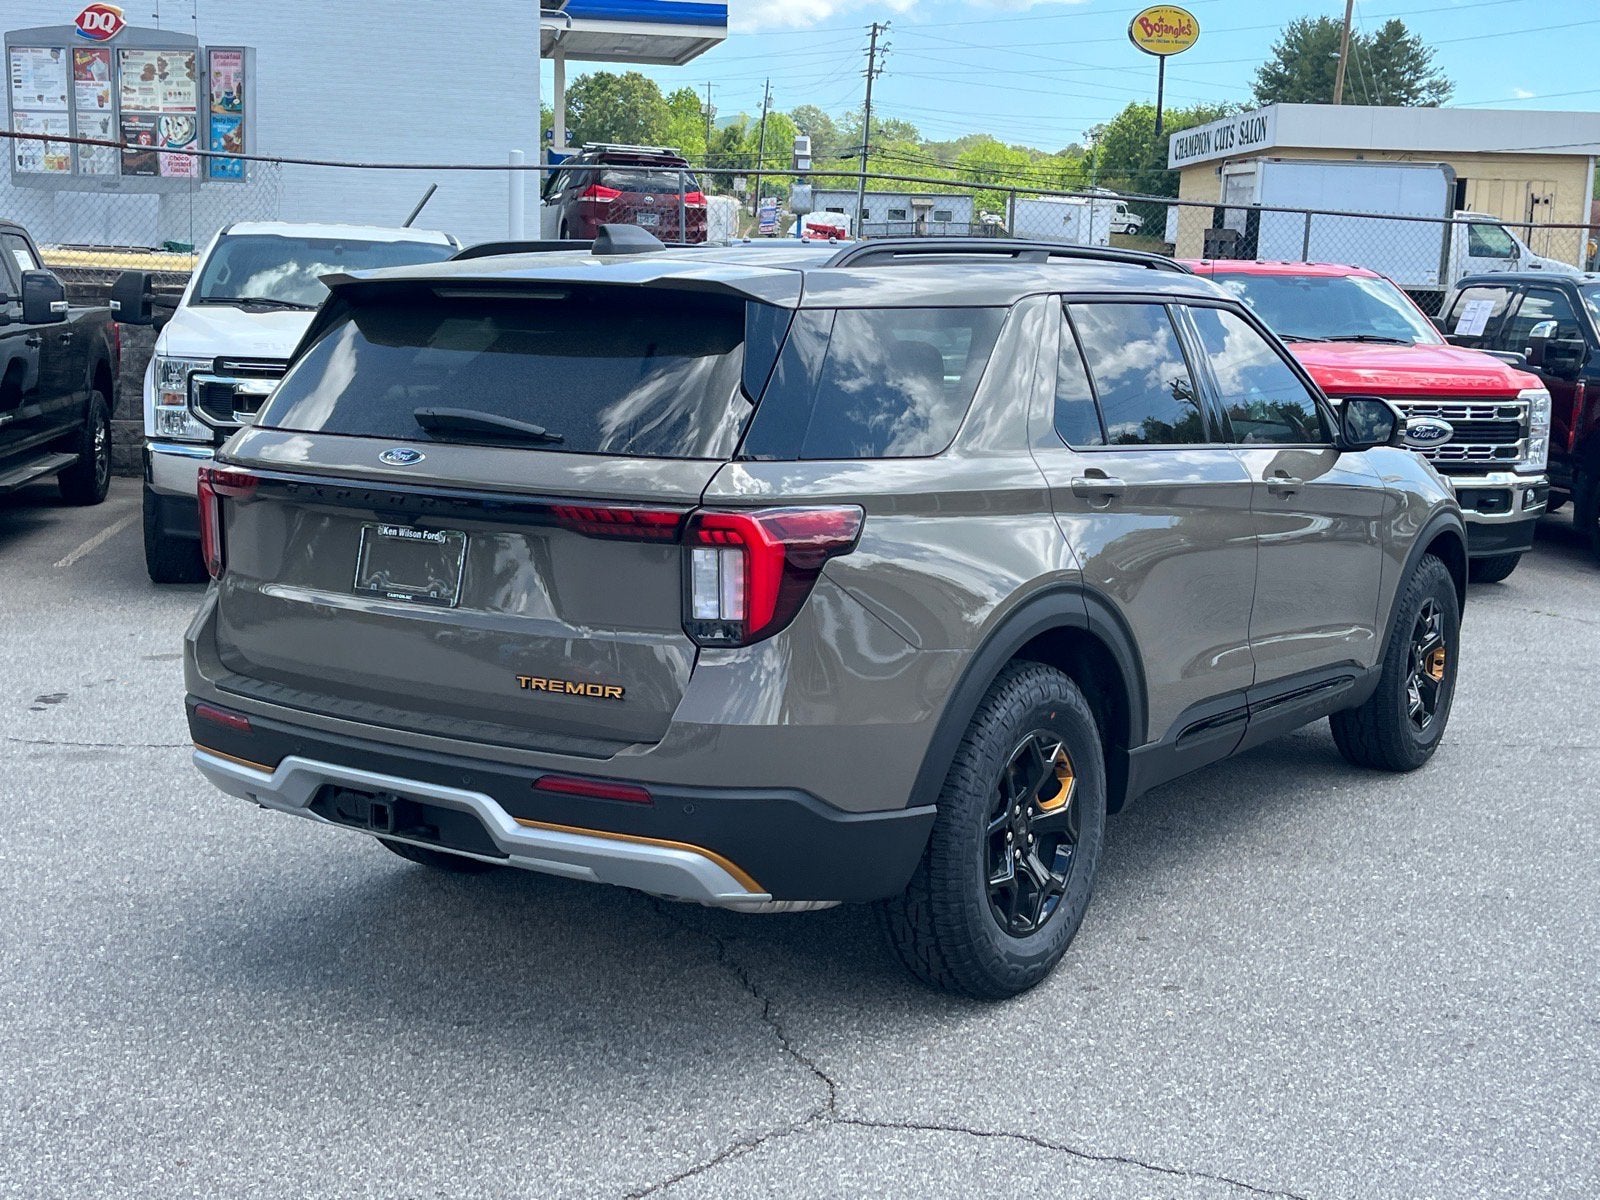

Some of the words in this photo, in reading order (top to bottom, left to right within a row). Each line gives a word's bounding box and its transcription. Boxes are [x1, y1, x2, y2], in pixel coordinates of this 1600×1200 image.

[82, 11, 116, 34] DQ
[1174, 131, 1211, 161] CHAMPION
[1214, 124, 1235, 152] CUTS
[1239, 115, 1268, 146] SALON
[1412, 425, 1441, 438] Ford
[383, 526, 397, 536] Ken
[399, 527, 421, 539] Wilson
[423, 530, 440, 541] Ford
[516, 675, 624, 699] TREMOR
